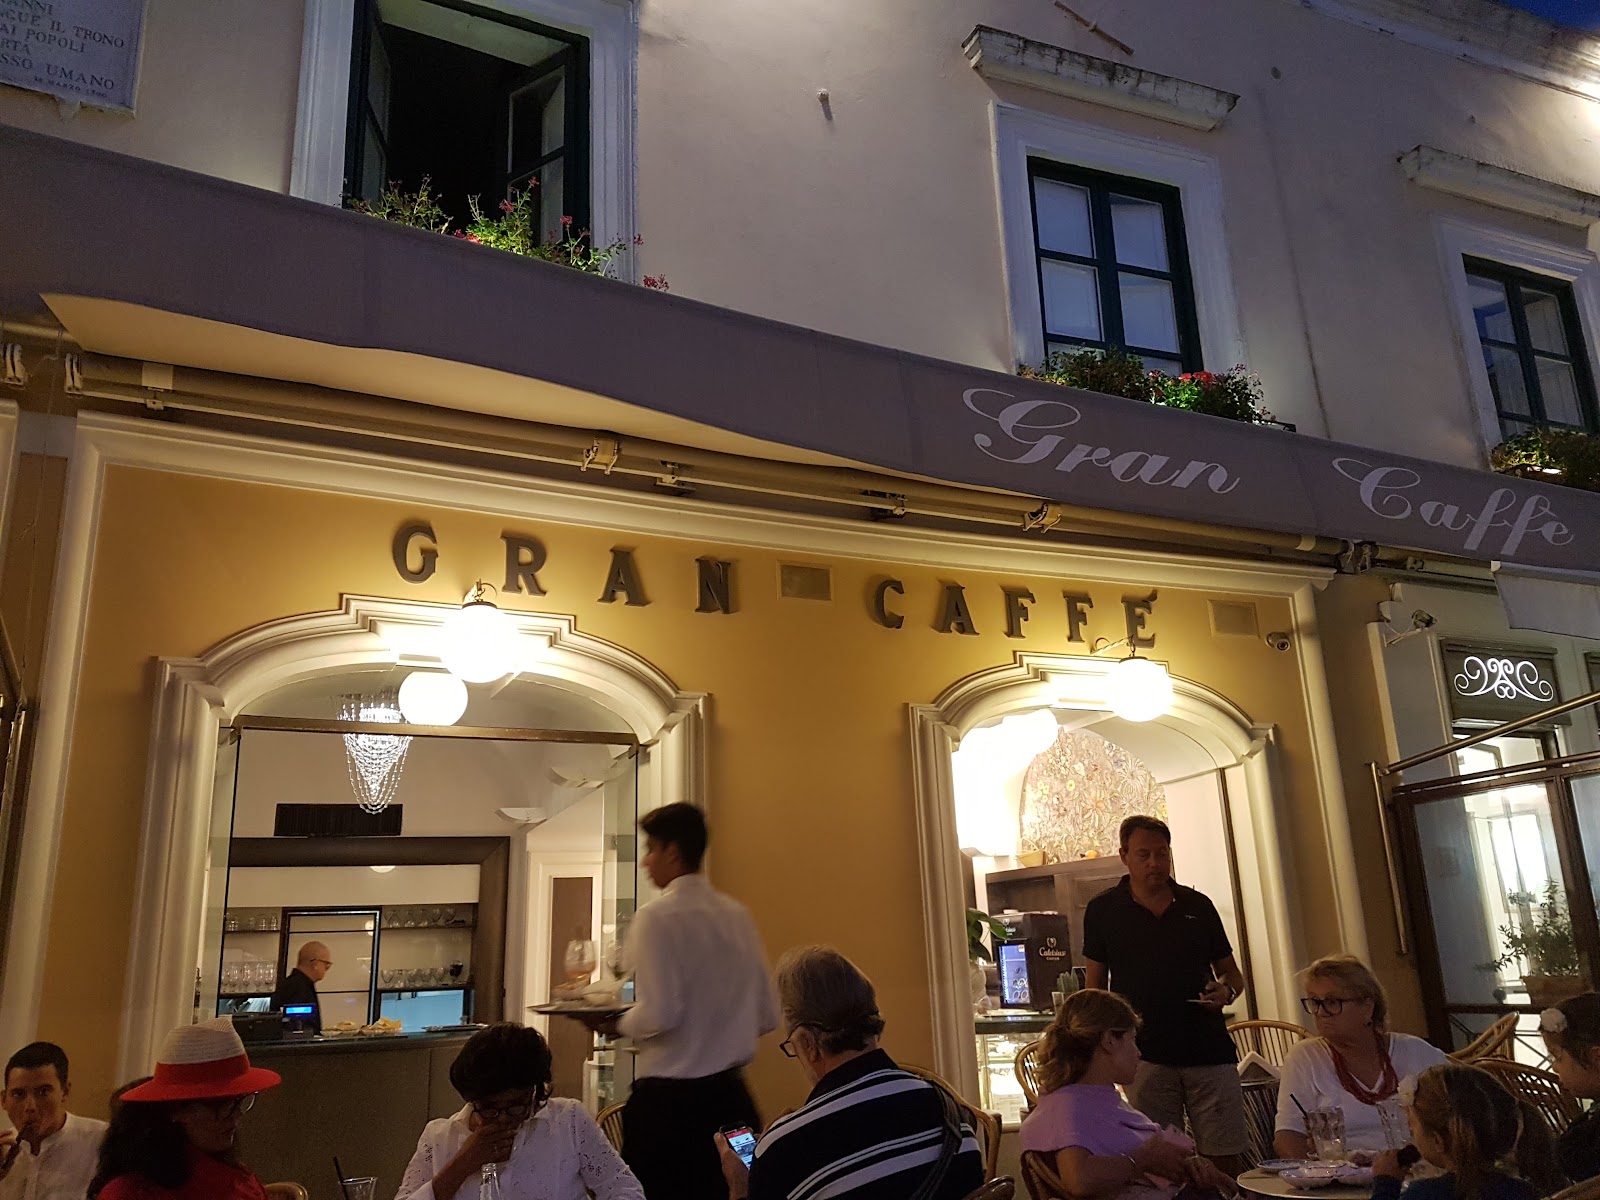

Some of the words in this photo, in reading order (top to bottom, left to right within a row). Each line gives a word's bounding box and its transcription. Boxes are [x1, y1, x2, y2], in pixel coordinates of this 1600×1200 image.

[26, 28, 85, 53] POPOLI
[50, 20, 65, 33] IL
[73, 25, 124, 48] TRONO
[46, 63, 114, 90] UMANO
[963, 388, 1241, 495] Gran
[392, 522, 735, 615] GRAN
